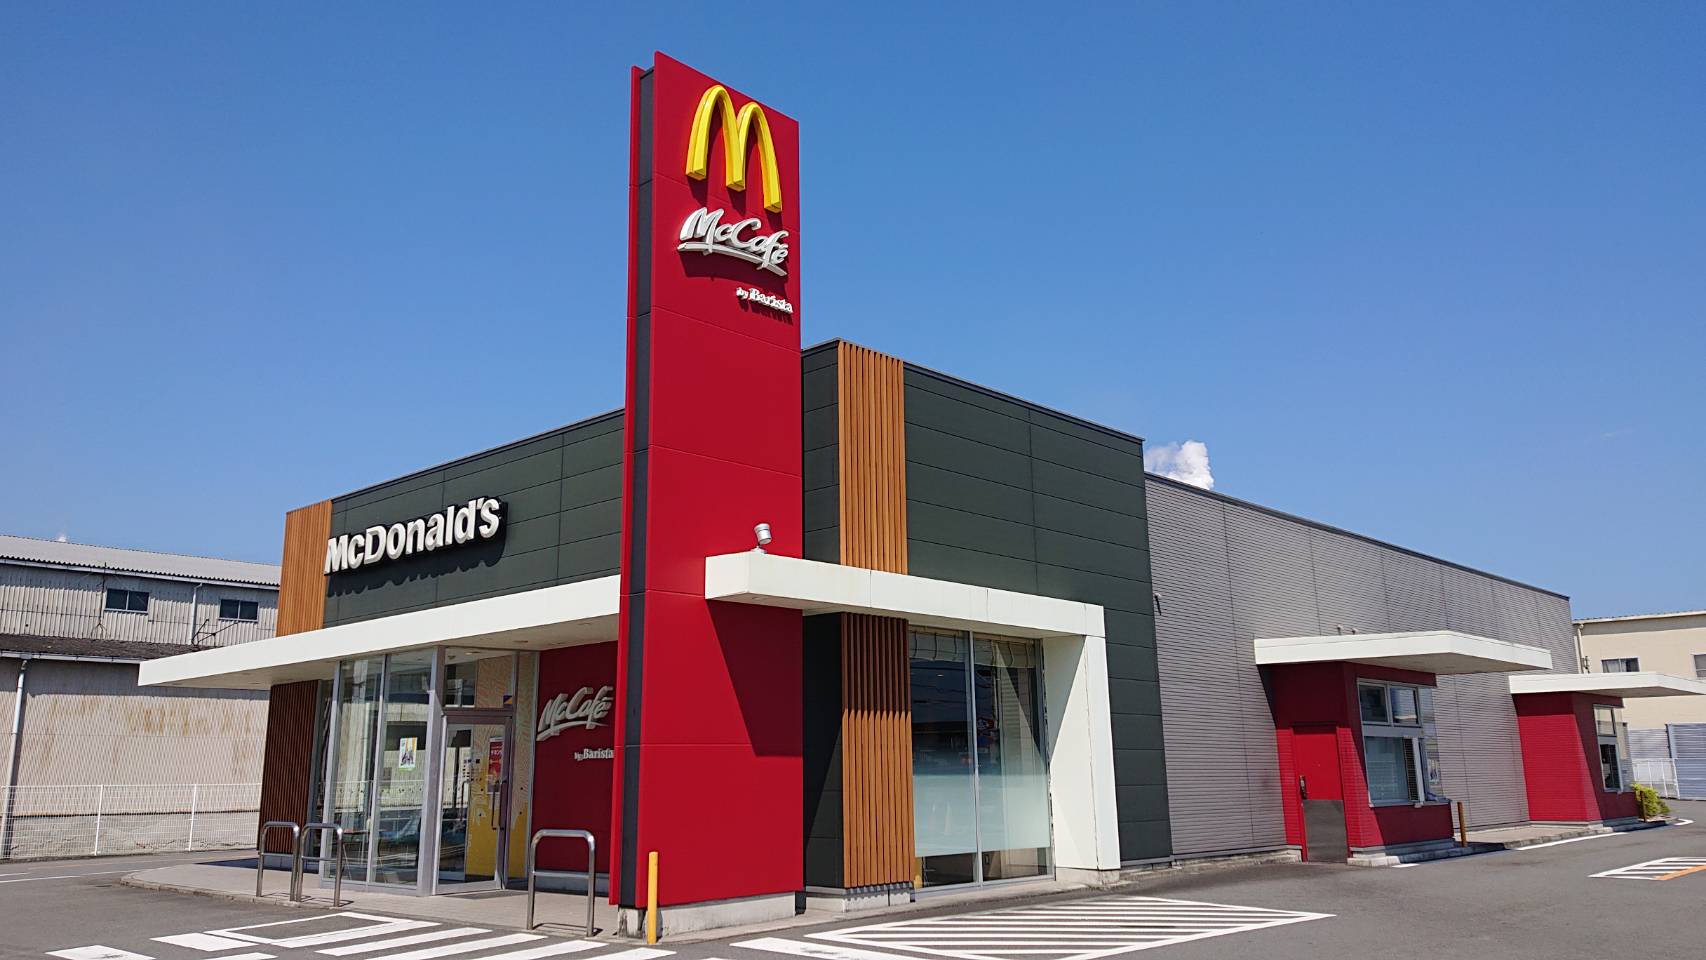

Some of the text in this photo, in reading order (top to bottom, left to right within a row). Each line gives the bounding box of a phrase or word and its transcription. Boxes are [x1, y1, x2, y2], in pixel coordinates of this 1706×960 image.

[677, 207, 790, 277] McCafé
[736, 287, 794, 315] by Barista
[324, 496, 502, 575] McDonald's
[536, 685, 614, 742] McCafé
